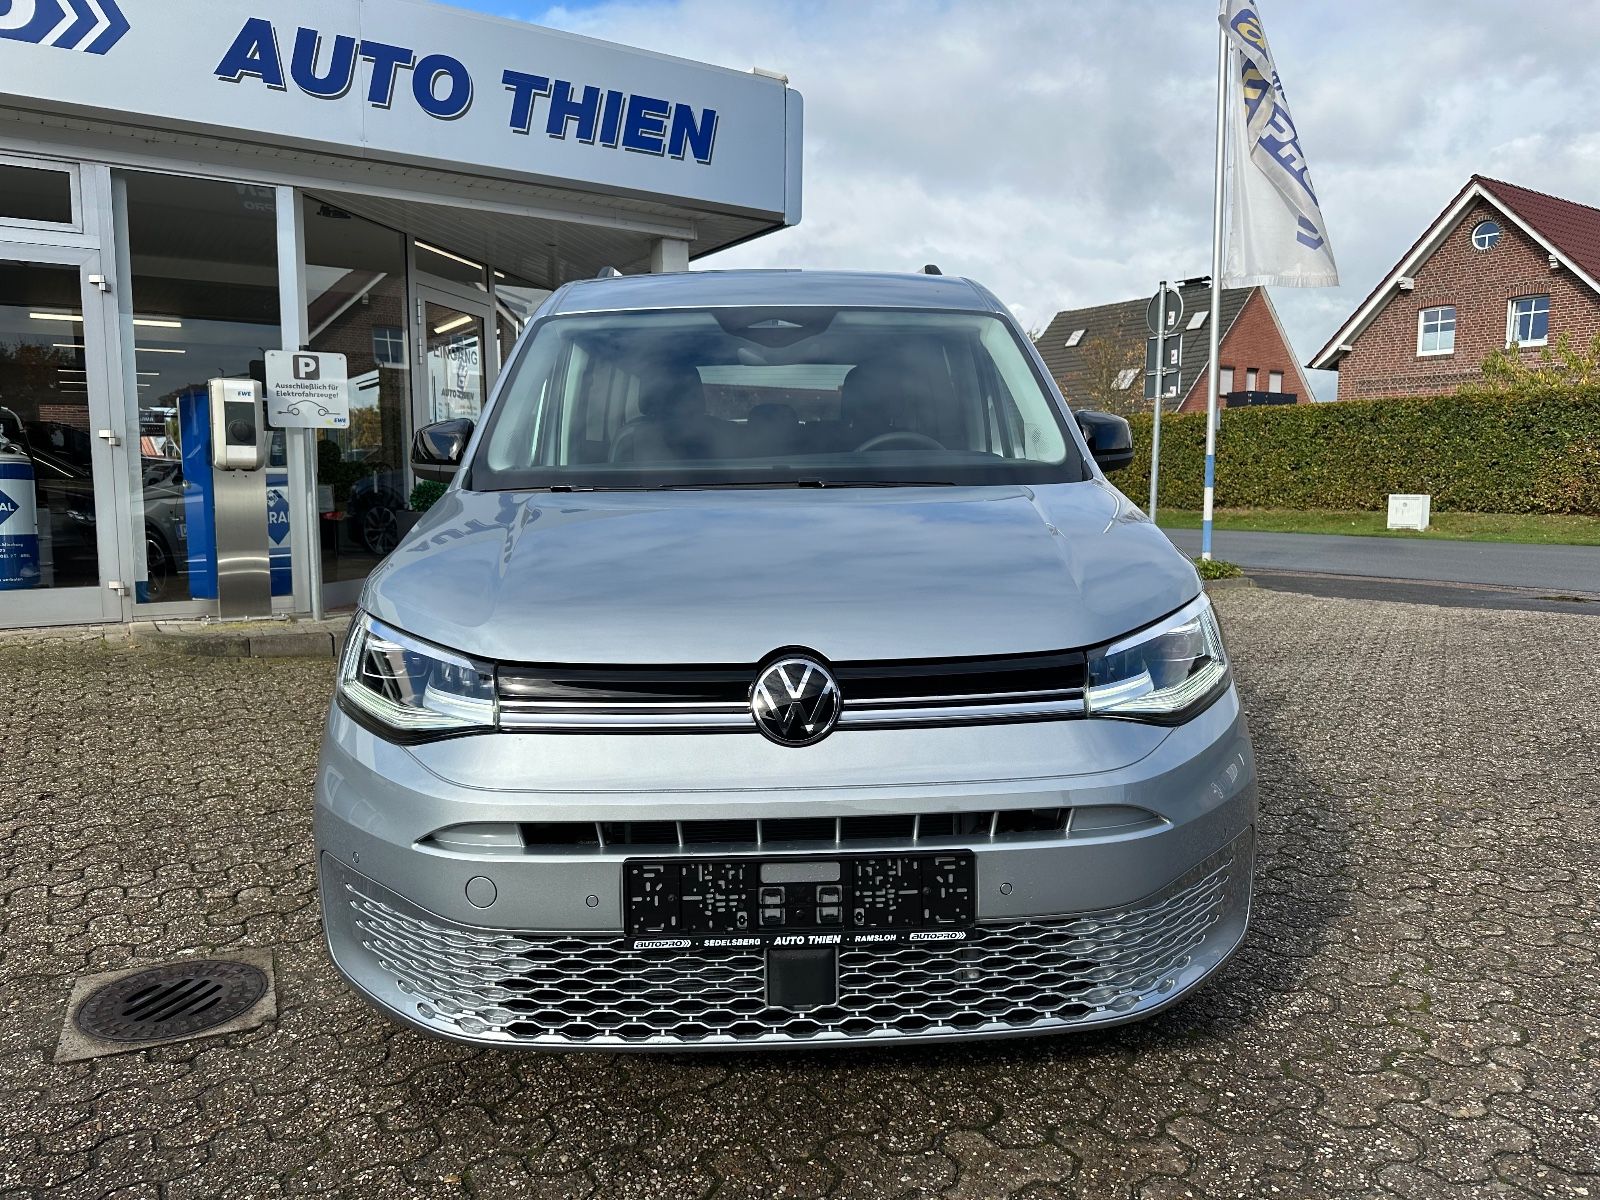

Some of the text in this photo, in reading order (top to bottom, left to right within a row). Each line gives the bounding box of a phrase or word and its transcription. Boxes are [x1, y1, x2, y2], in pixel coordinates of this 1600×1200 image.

[213, 17, 720, 165] AUTO THIEN
[299, 357, 316, 378] P
[275, 382, 327, 391] Ausschließlich
[276, 390, 339, 400] Elektrofahrzeuge!
[0, 502, 15, 512] AL
[268, 511, 290, 524] RA
[704, 939, 761, 947] SEDELSBERG
[774, 936, 805, 946] AUTO
[808, 935, 841, 945] THIEN
[855, 934, 897, 943] RAMSLOH
